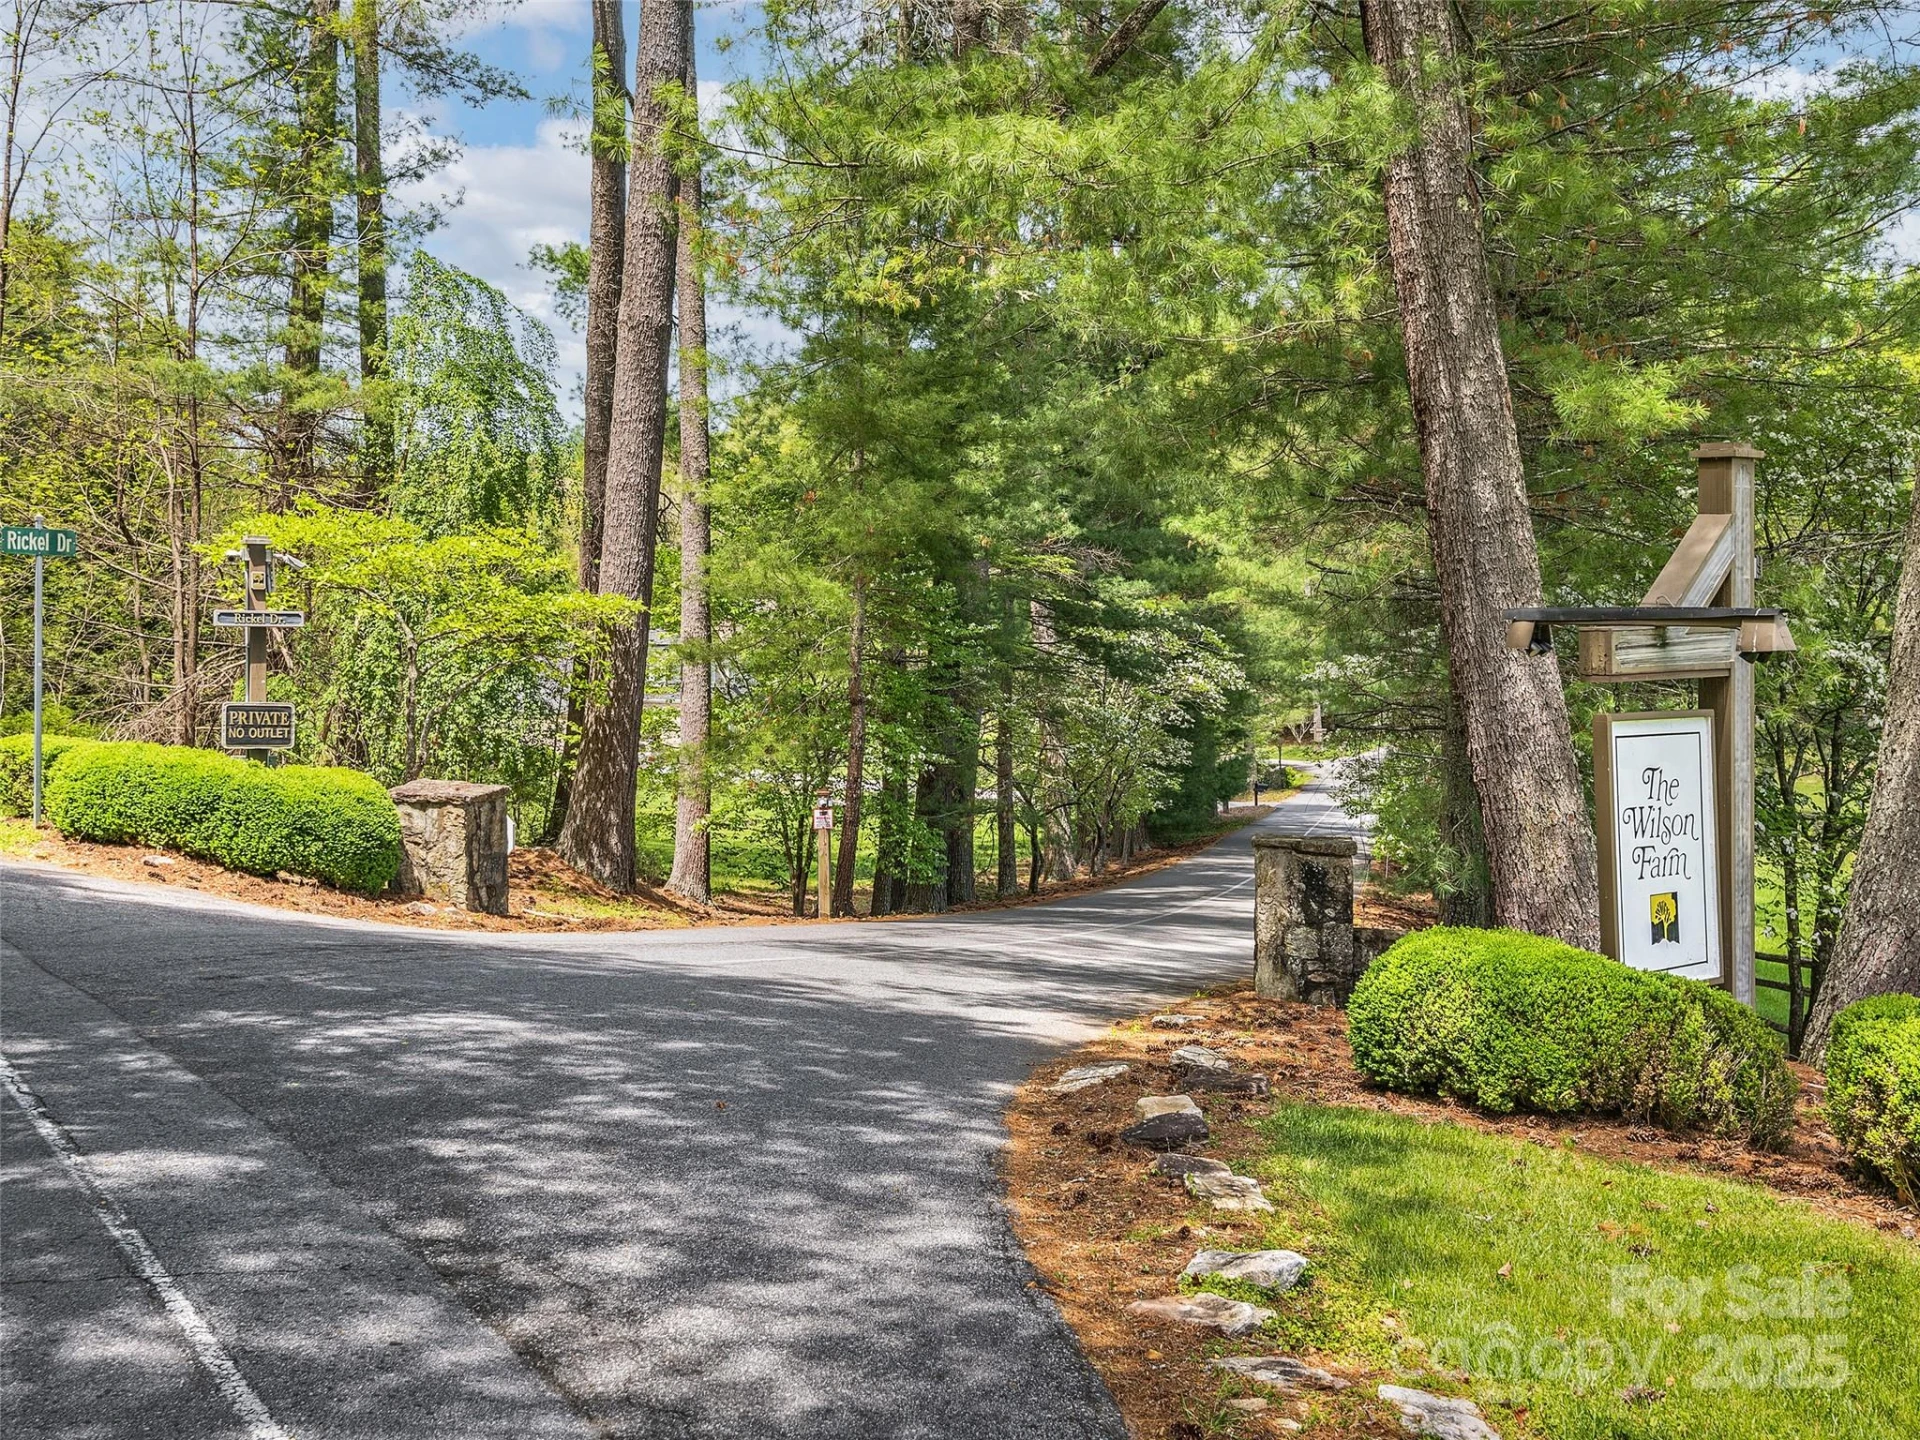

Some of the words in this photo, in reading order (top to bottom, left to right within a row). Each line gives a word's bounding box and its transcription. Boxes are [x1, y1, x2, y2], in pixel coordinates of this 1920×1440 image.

[7, 530, 50, 552] Rickel
[57, 532, 73, 553] Dr
[234, 613, 265, 624] Rickel
[270, 614, 286, 625] Dr.
[228, 710, 290, 726] PRIVATE
[228, 727, 245, 739] NO
[248, 727, 290, 739] OUTLET
[1641, 765, 1680, 806] The
[1622, 805, 1700, 845] Wilson
[1631, 845, 1692, 881] Farm
